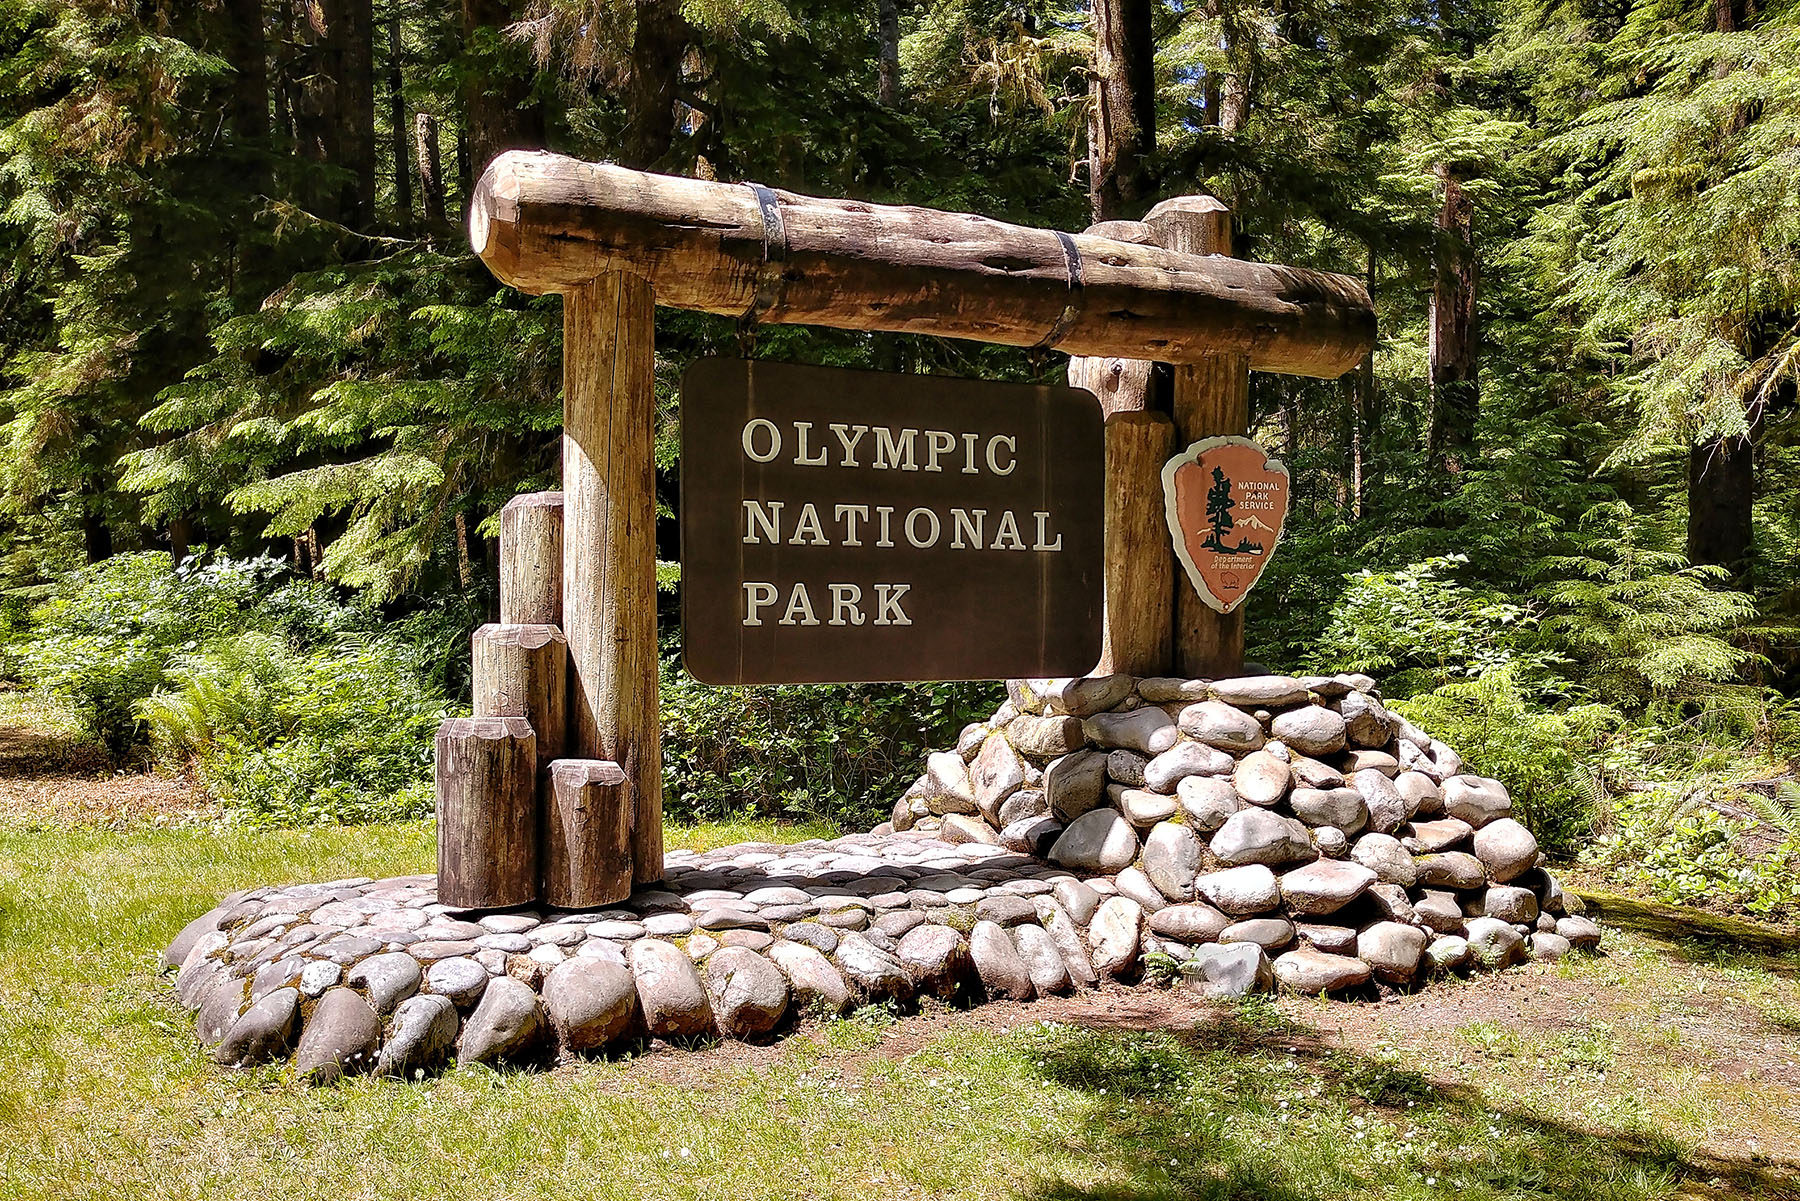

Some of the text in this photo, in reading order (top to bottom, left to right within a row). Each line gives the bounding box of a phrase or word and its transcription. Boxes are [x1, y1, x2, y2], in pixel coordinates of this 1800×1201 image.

[742, 418, 1017, 476] OLYMPIC
[1238, 481, 1280, 491] NATIONAL
[1245, 492, 1269, 500] PARK
[1239, 501, 1274, 510] SERVICE
[742, 500, 1063, 551] NATIONAL
[1214, 555, 1253, 564] Department
[742, 582, 912, 626] PARK
